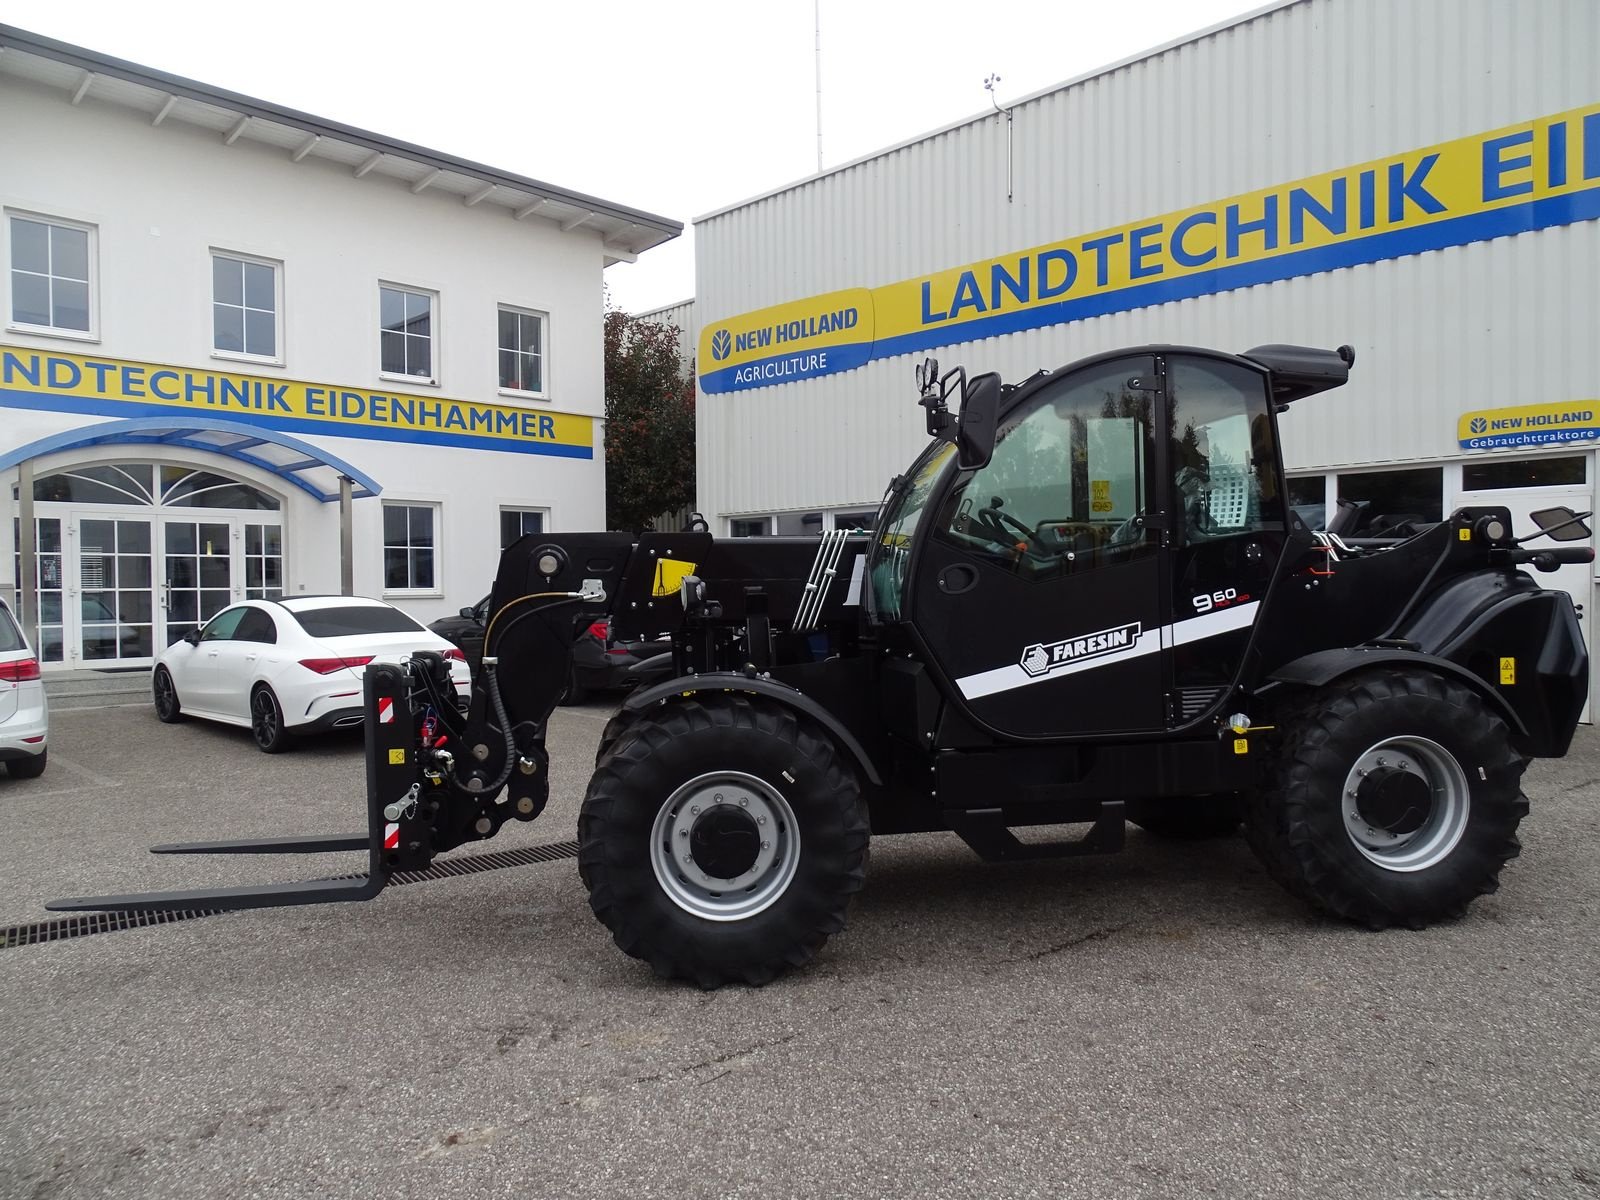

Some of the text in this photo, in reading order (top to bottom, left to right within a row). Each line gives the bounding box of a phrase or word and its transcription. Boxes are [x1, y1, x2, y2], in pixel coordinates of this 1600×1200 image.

[921, 153, 1448, 325] LANDTECHNIK
[735, 307, 858, 352] NEW HOLLAND
[734, 353, 827, 384] AGRICULTURE
[3, 352, 556, 439] NDTECHNIK EIDENHAMMER
[1491, 410, 1593, 430] NEW HOLLAND
[1470, 430, 1594, 448] Gebrauchttraktore
[1053, 629, 1127, 661] FARESIN
